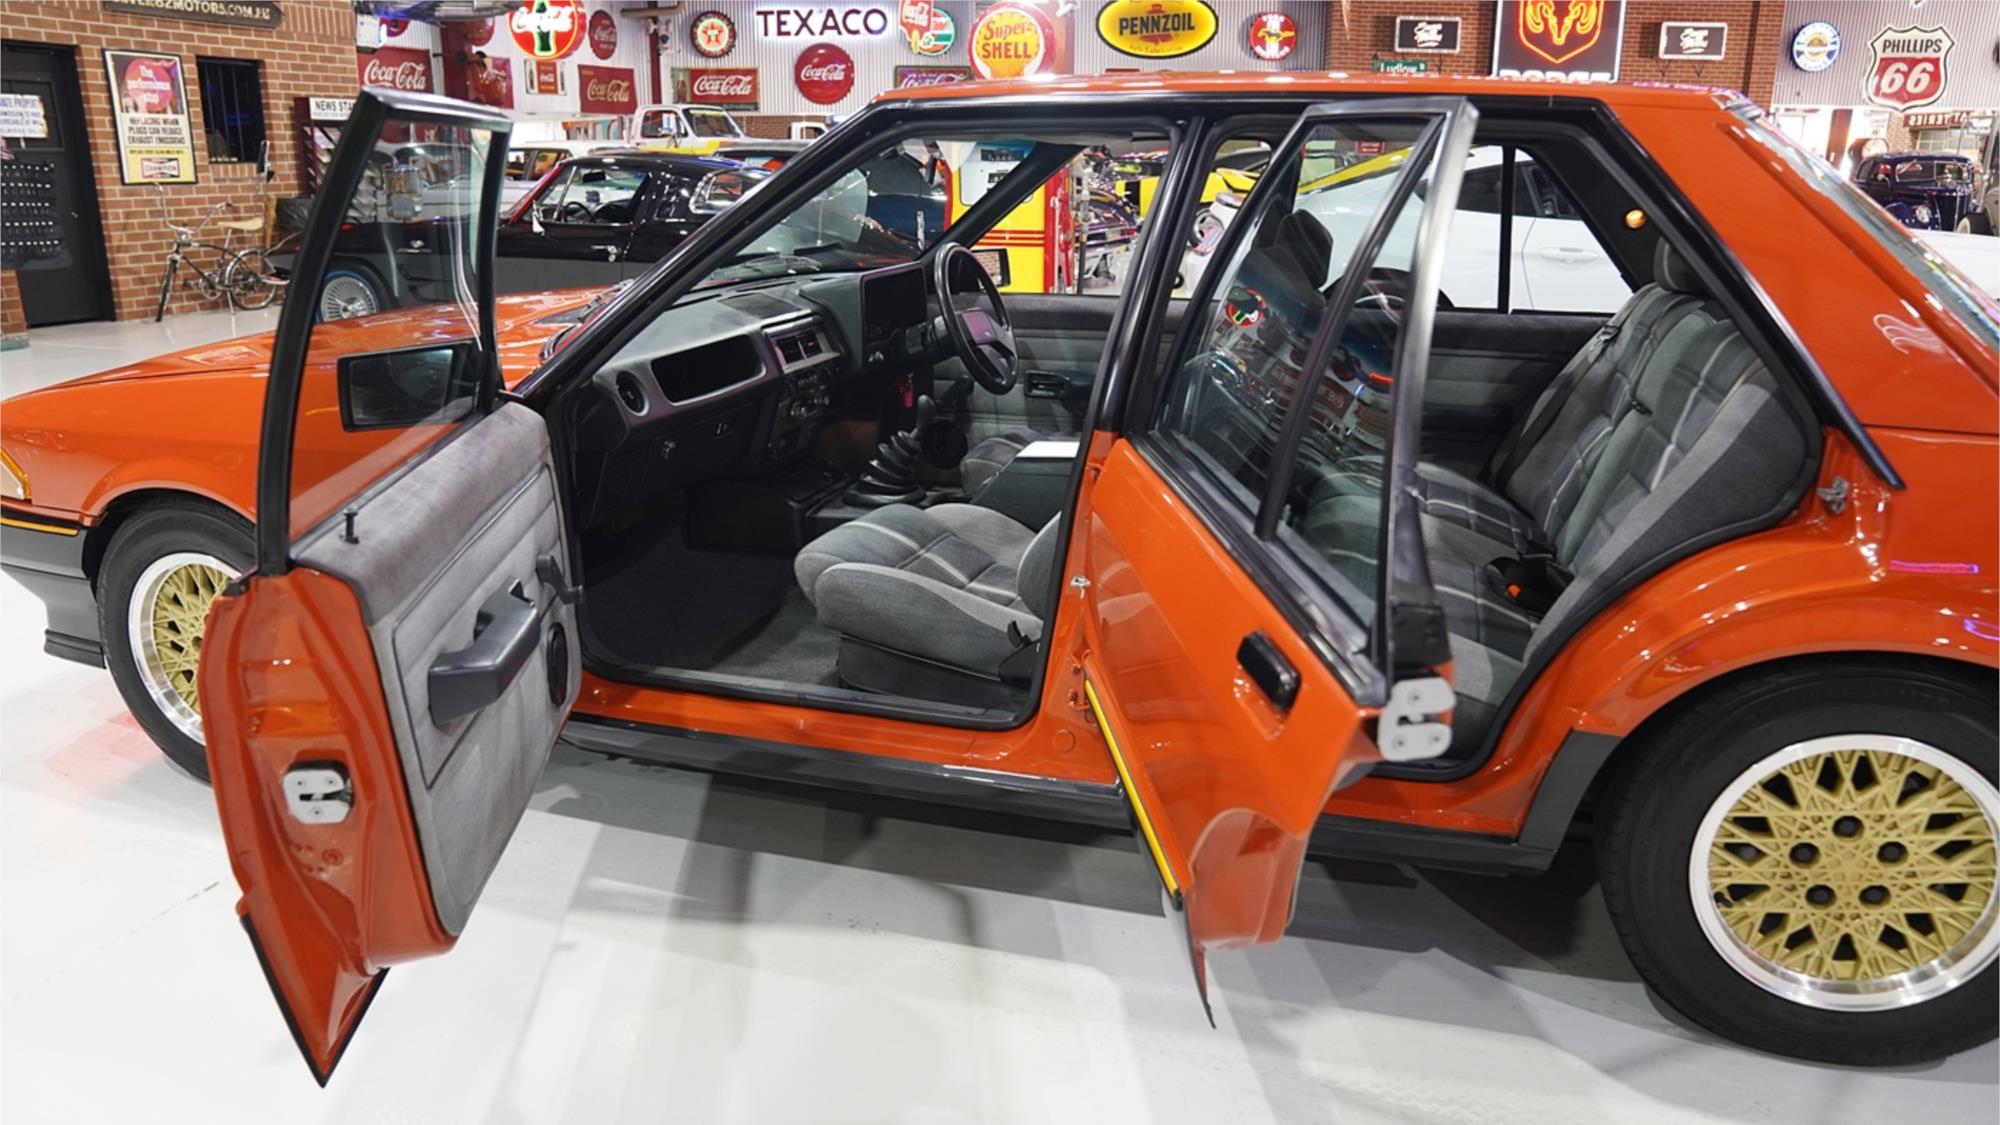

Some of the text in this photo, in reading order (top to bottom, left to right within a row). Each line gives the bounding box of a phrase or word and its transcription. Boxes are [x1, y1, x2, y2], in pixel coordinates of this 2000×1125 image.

[756, 8, 888, 36] TEXACO
[1119, 12, 1196, 36] PENNZOIL
[982, 42, 1032, 59] SHELL
[1882, 39, 1943, 54] PHILLIPS
[1880, 62, 1935, 94] 66
[315, 101, 337, 112] NEWS
